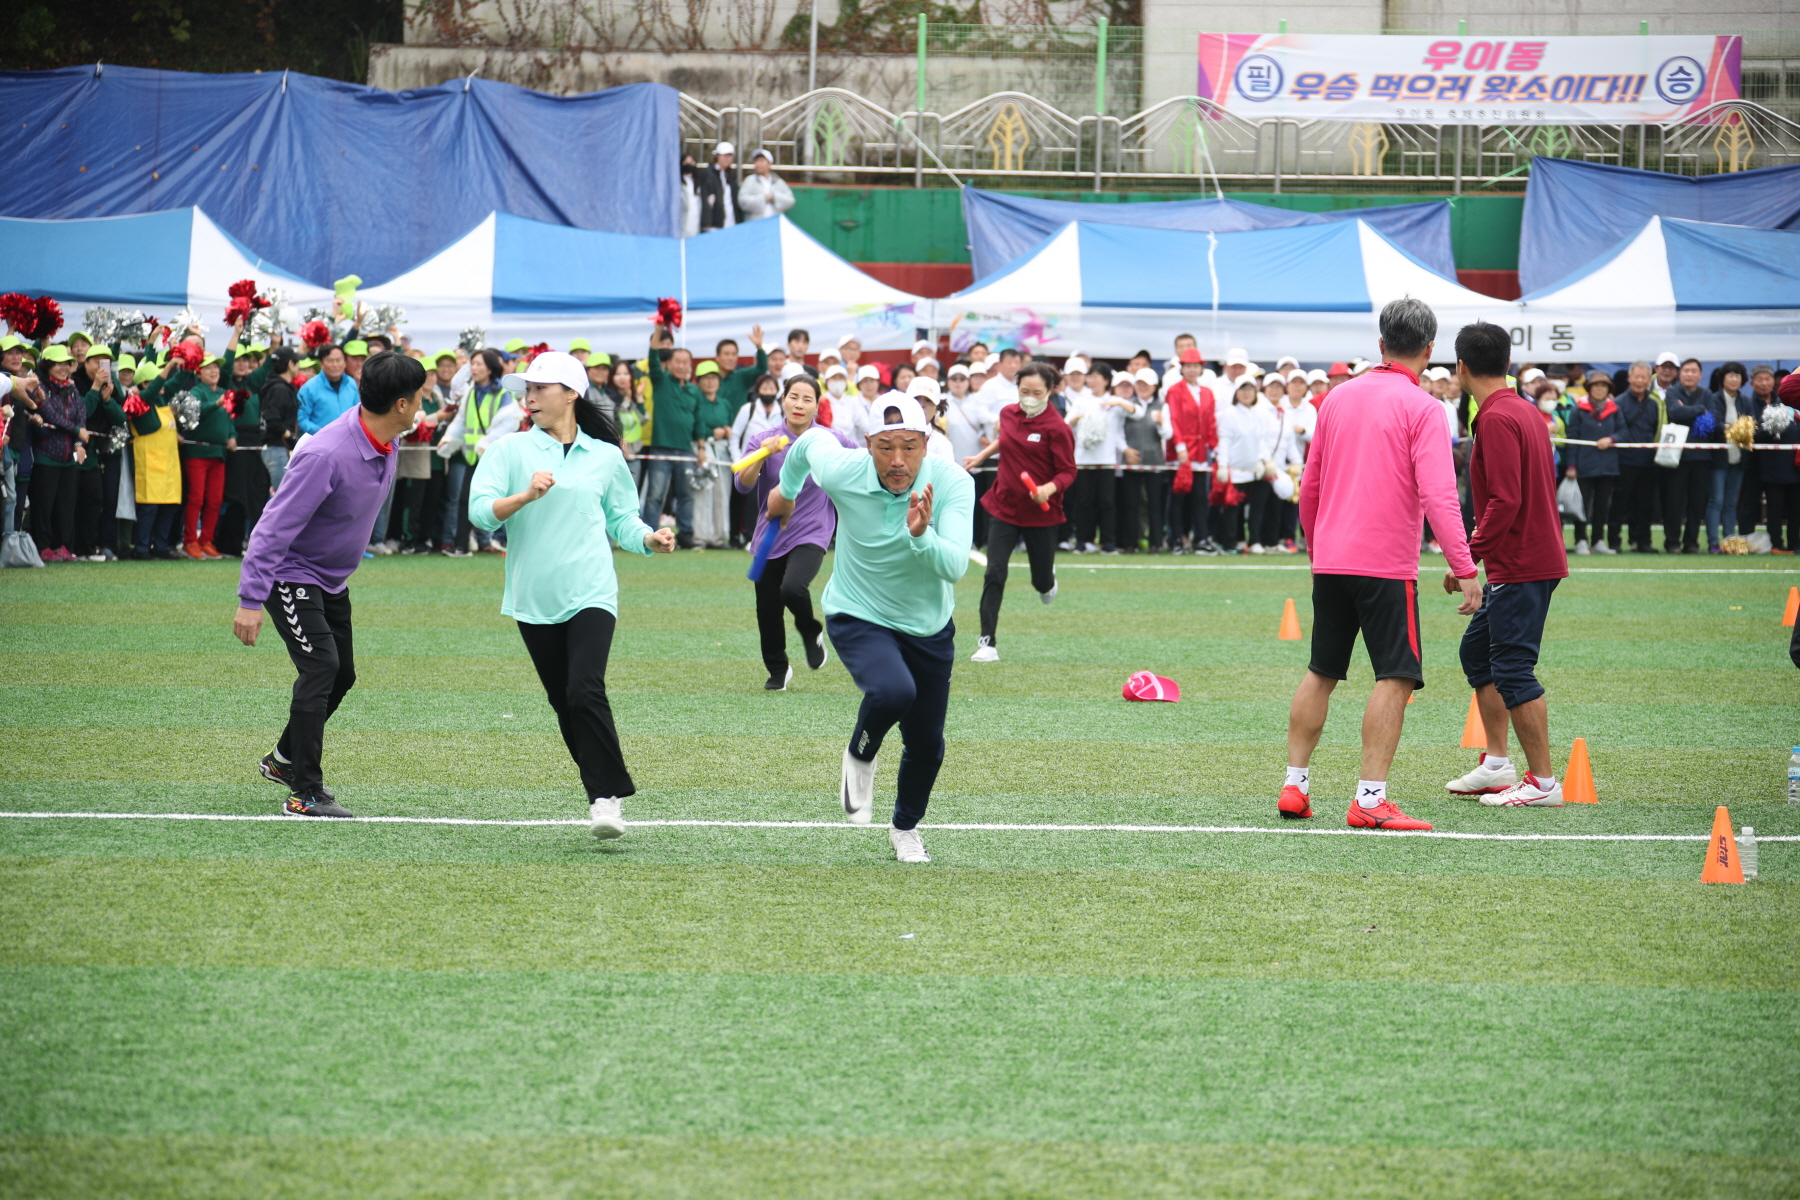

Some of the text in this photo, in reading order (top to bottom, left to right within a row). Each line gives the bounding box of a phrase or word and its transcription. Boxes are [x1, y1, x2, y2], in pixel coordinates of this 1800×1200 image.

[1422, 41, 1548, 72] 우이동
[1246, 65, 1271, 92] 필
[1290, 72, 1360, 101] 우승
[1368, 74, 1476, 103] 먹으러
[1666, 65, 1694, 94] 승
[1510, 324, 1575, 351] 이동
